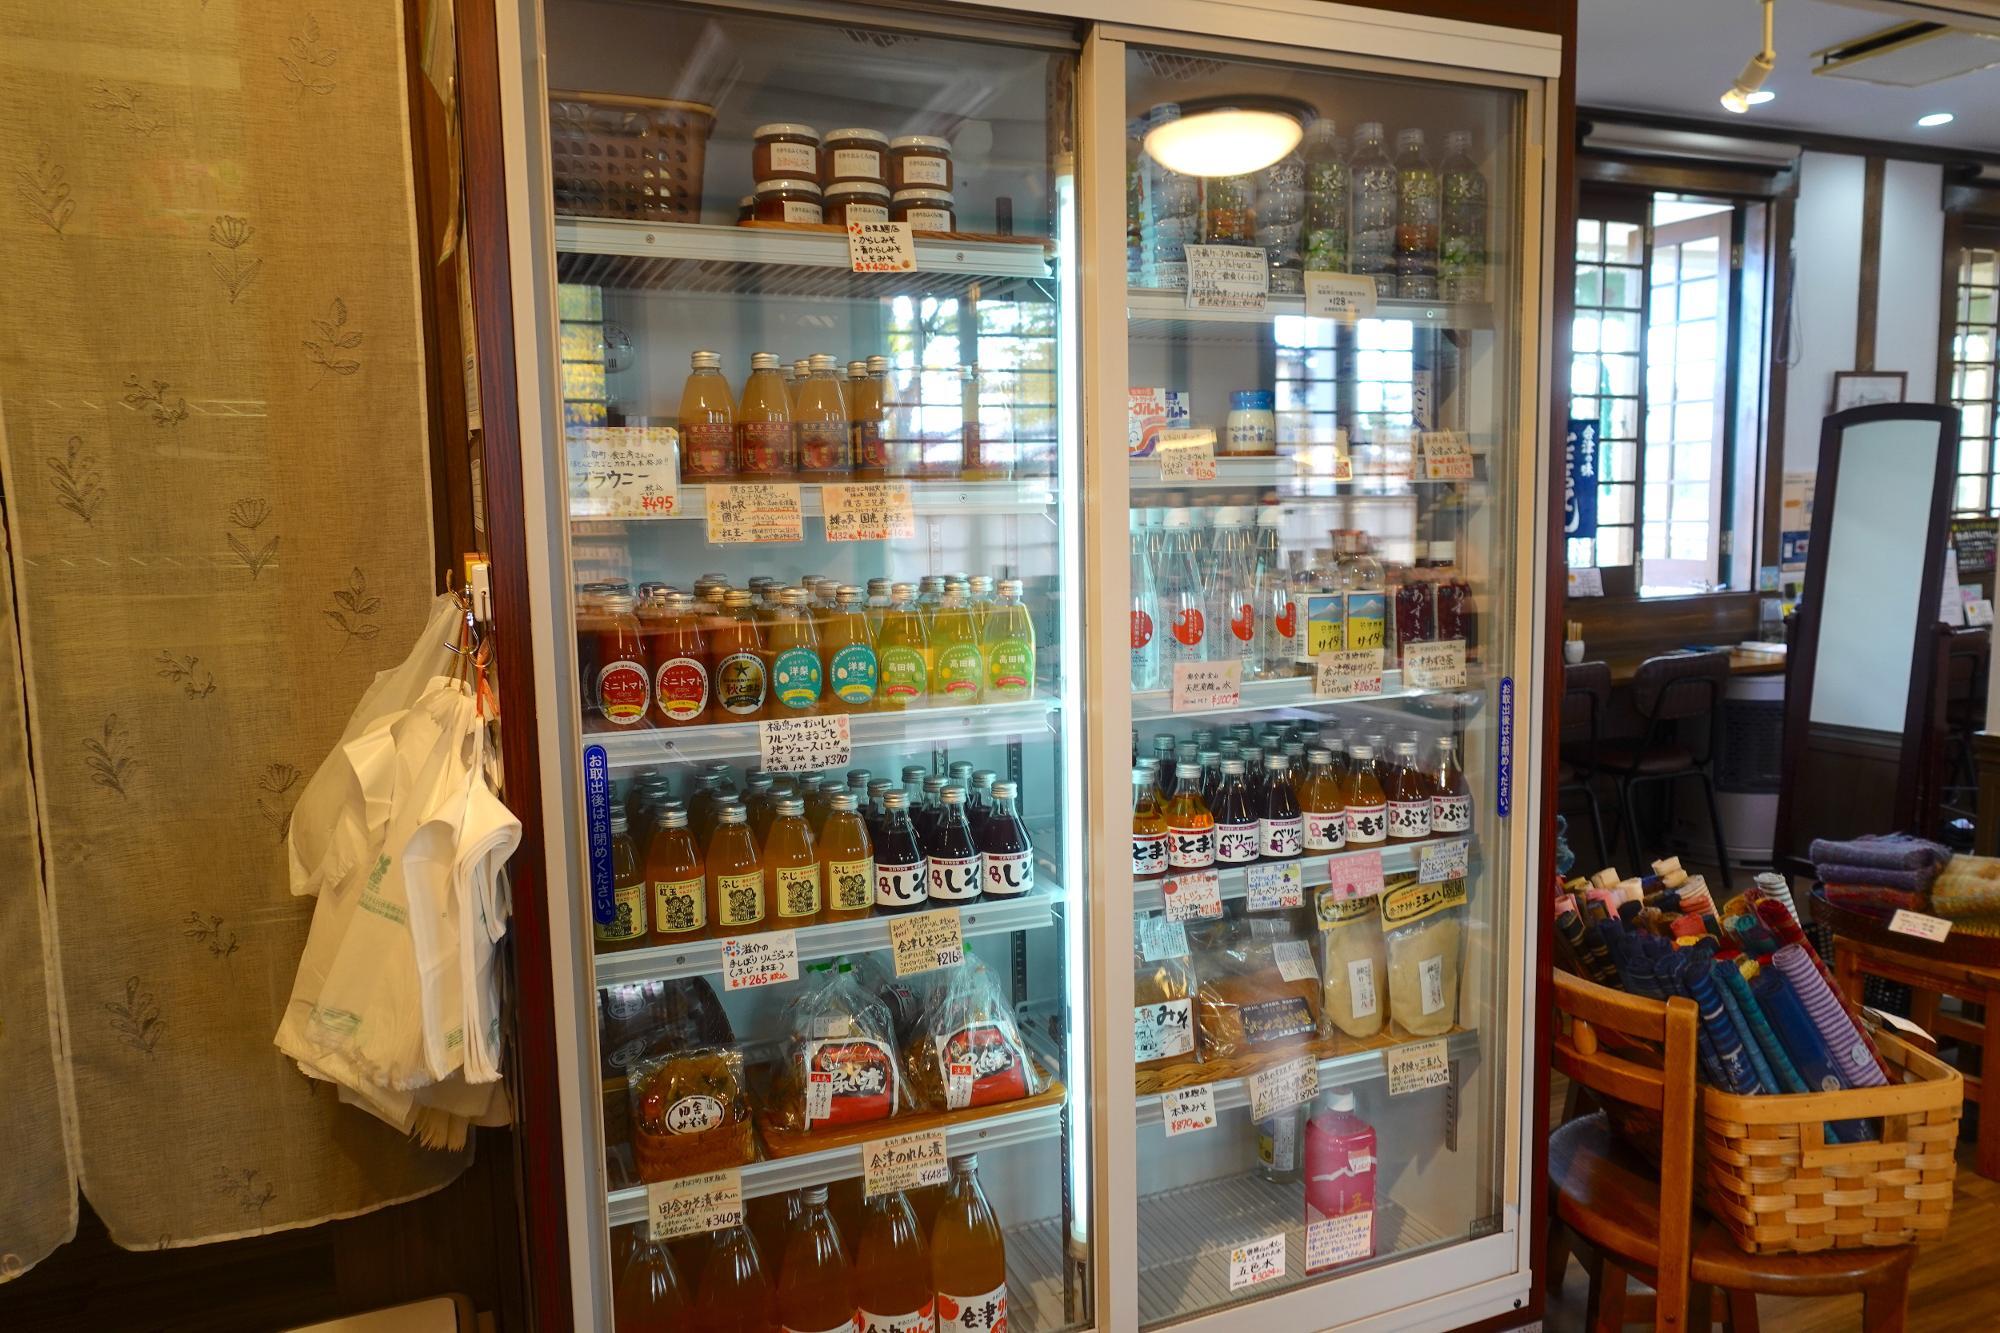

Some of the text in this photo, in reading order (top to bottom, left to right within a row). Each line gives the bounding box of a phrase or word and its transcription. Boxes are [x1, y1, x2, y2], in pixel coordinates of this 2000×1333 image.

[576, 470, 650, 489] ブラウニー
[641, 495, 674, 510] ¥495
[790, 665, 809, 676] 洋梨
[848, 661, 867, 671] 洋梨
[603, 680, 644, 692] ミニトマト
[662, 676, 703, 687] ミニトマト
[767, 718, 836, 732] 福島のおいしい
[766, 729, 838, 744] フルーツをまるごと
[824, 754, 849, 766] ¥370
[1357, 814, 1384, 836] もも
[588, 754, 611, 916] お取出後はお閉めください。
[1221, 834, 1254, 844] ベリー
[1178, 834, 1214, 853] とま
[780, 871, 798, 881] ふじ
[832, 865, 849, 875] ふじ
[721, 880, 740, 889] ふじ
[892, 869, 927, 900] しそ
[944, 864, 980, 894] しそ
[659, 888, 677, 897] 紅玉
[1168, 888, 1214, 907] トマトジュース
[897, 930, 959, 953] 会津しそジュース
[936, 950, 959, 966] ¥216
[742, 972, 769, 986] ¥265
[1156, 1004, 1188, 1030] みそ
[679, 1101, 702, 1118] 田舎
[870, 1141, 942, 1168] 会津のれん漬
[920, 1169, 942, 1183] ¥648
[658, 1192, 713, 1216] 田舎みそ漬
[705, 1212, 734, 1228] ¥340
[1236, 1258, 1275, 1278] 五色水
[960, 1301, 998, 1329] 会津
